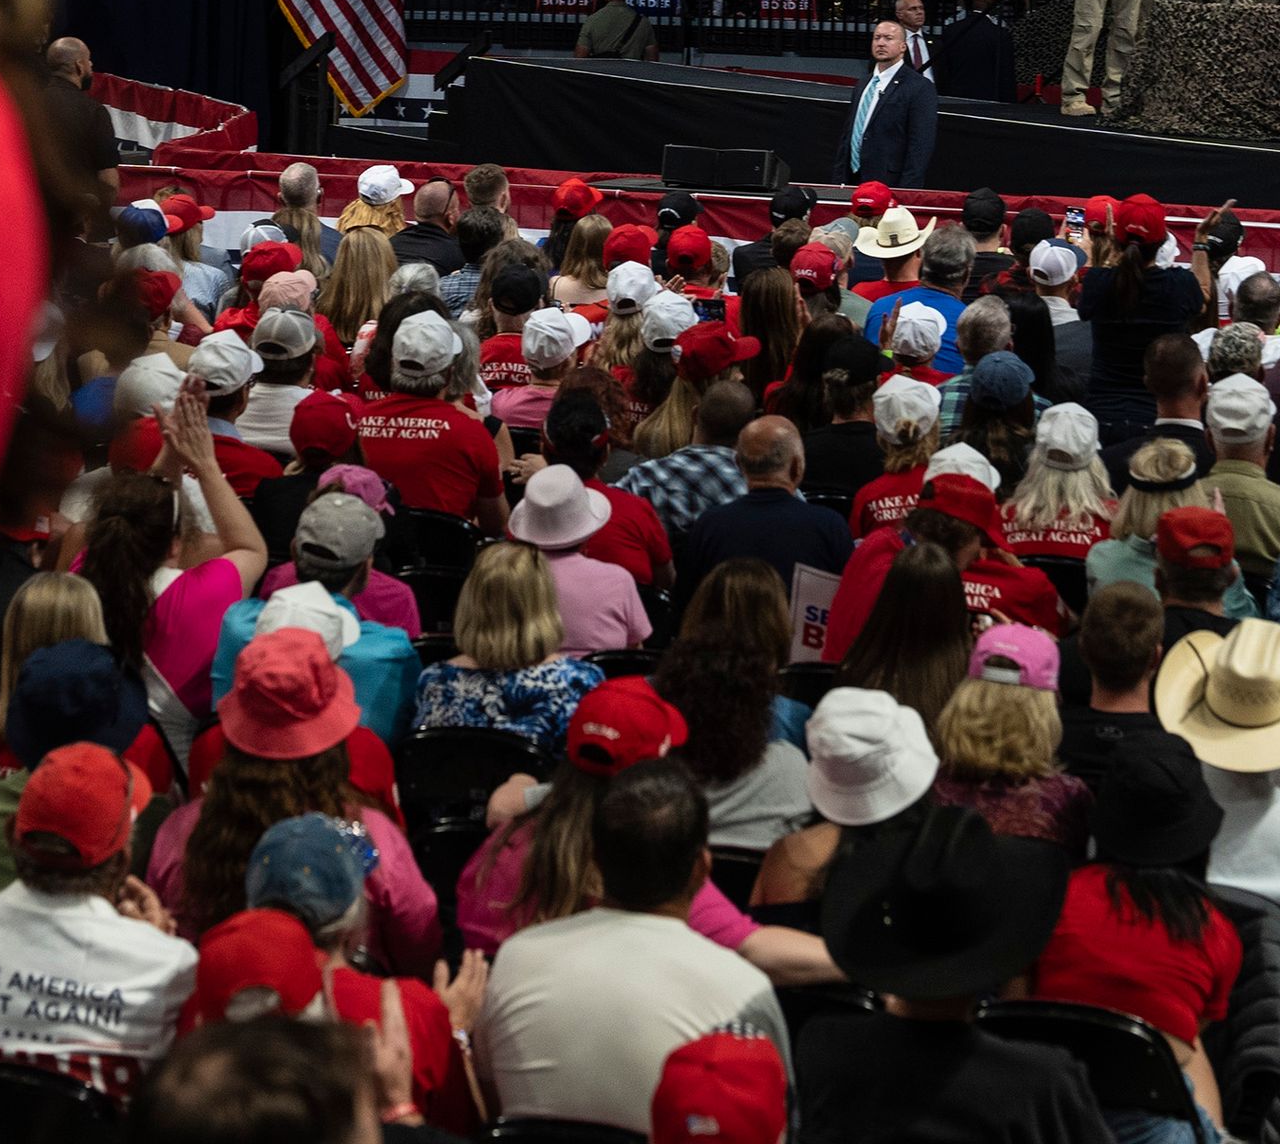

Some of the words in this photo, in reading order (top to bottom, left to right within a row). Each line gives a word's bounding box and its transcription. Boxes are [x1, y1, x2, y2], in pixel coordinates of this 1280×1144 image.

[388, 417, 451, 430] AMERICA
[397, 428, 441, 439] AGAIN
[868, 496, 904, 512] MAKE
[1006, 531, 1043, 544] GREAT
[1049, 530, 1092, 546] AGAIN
[7, 971, 126, 1006] AMERICA
[23, 998, 123, 1027] AGAIN!
